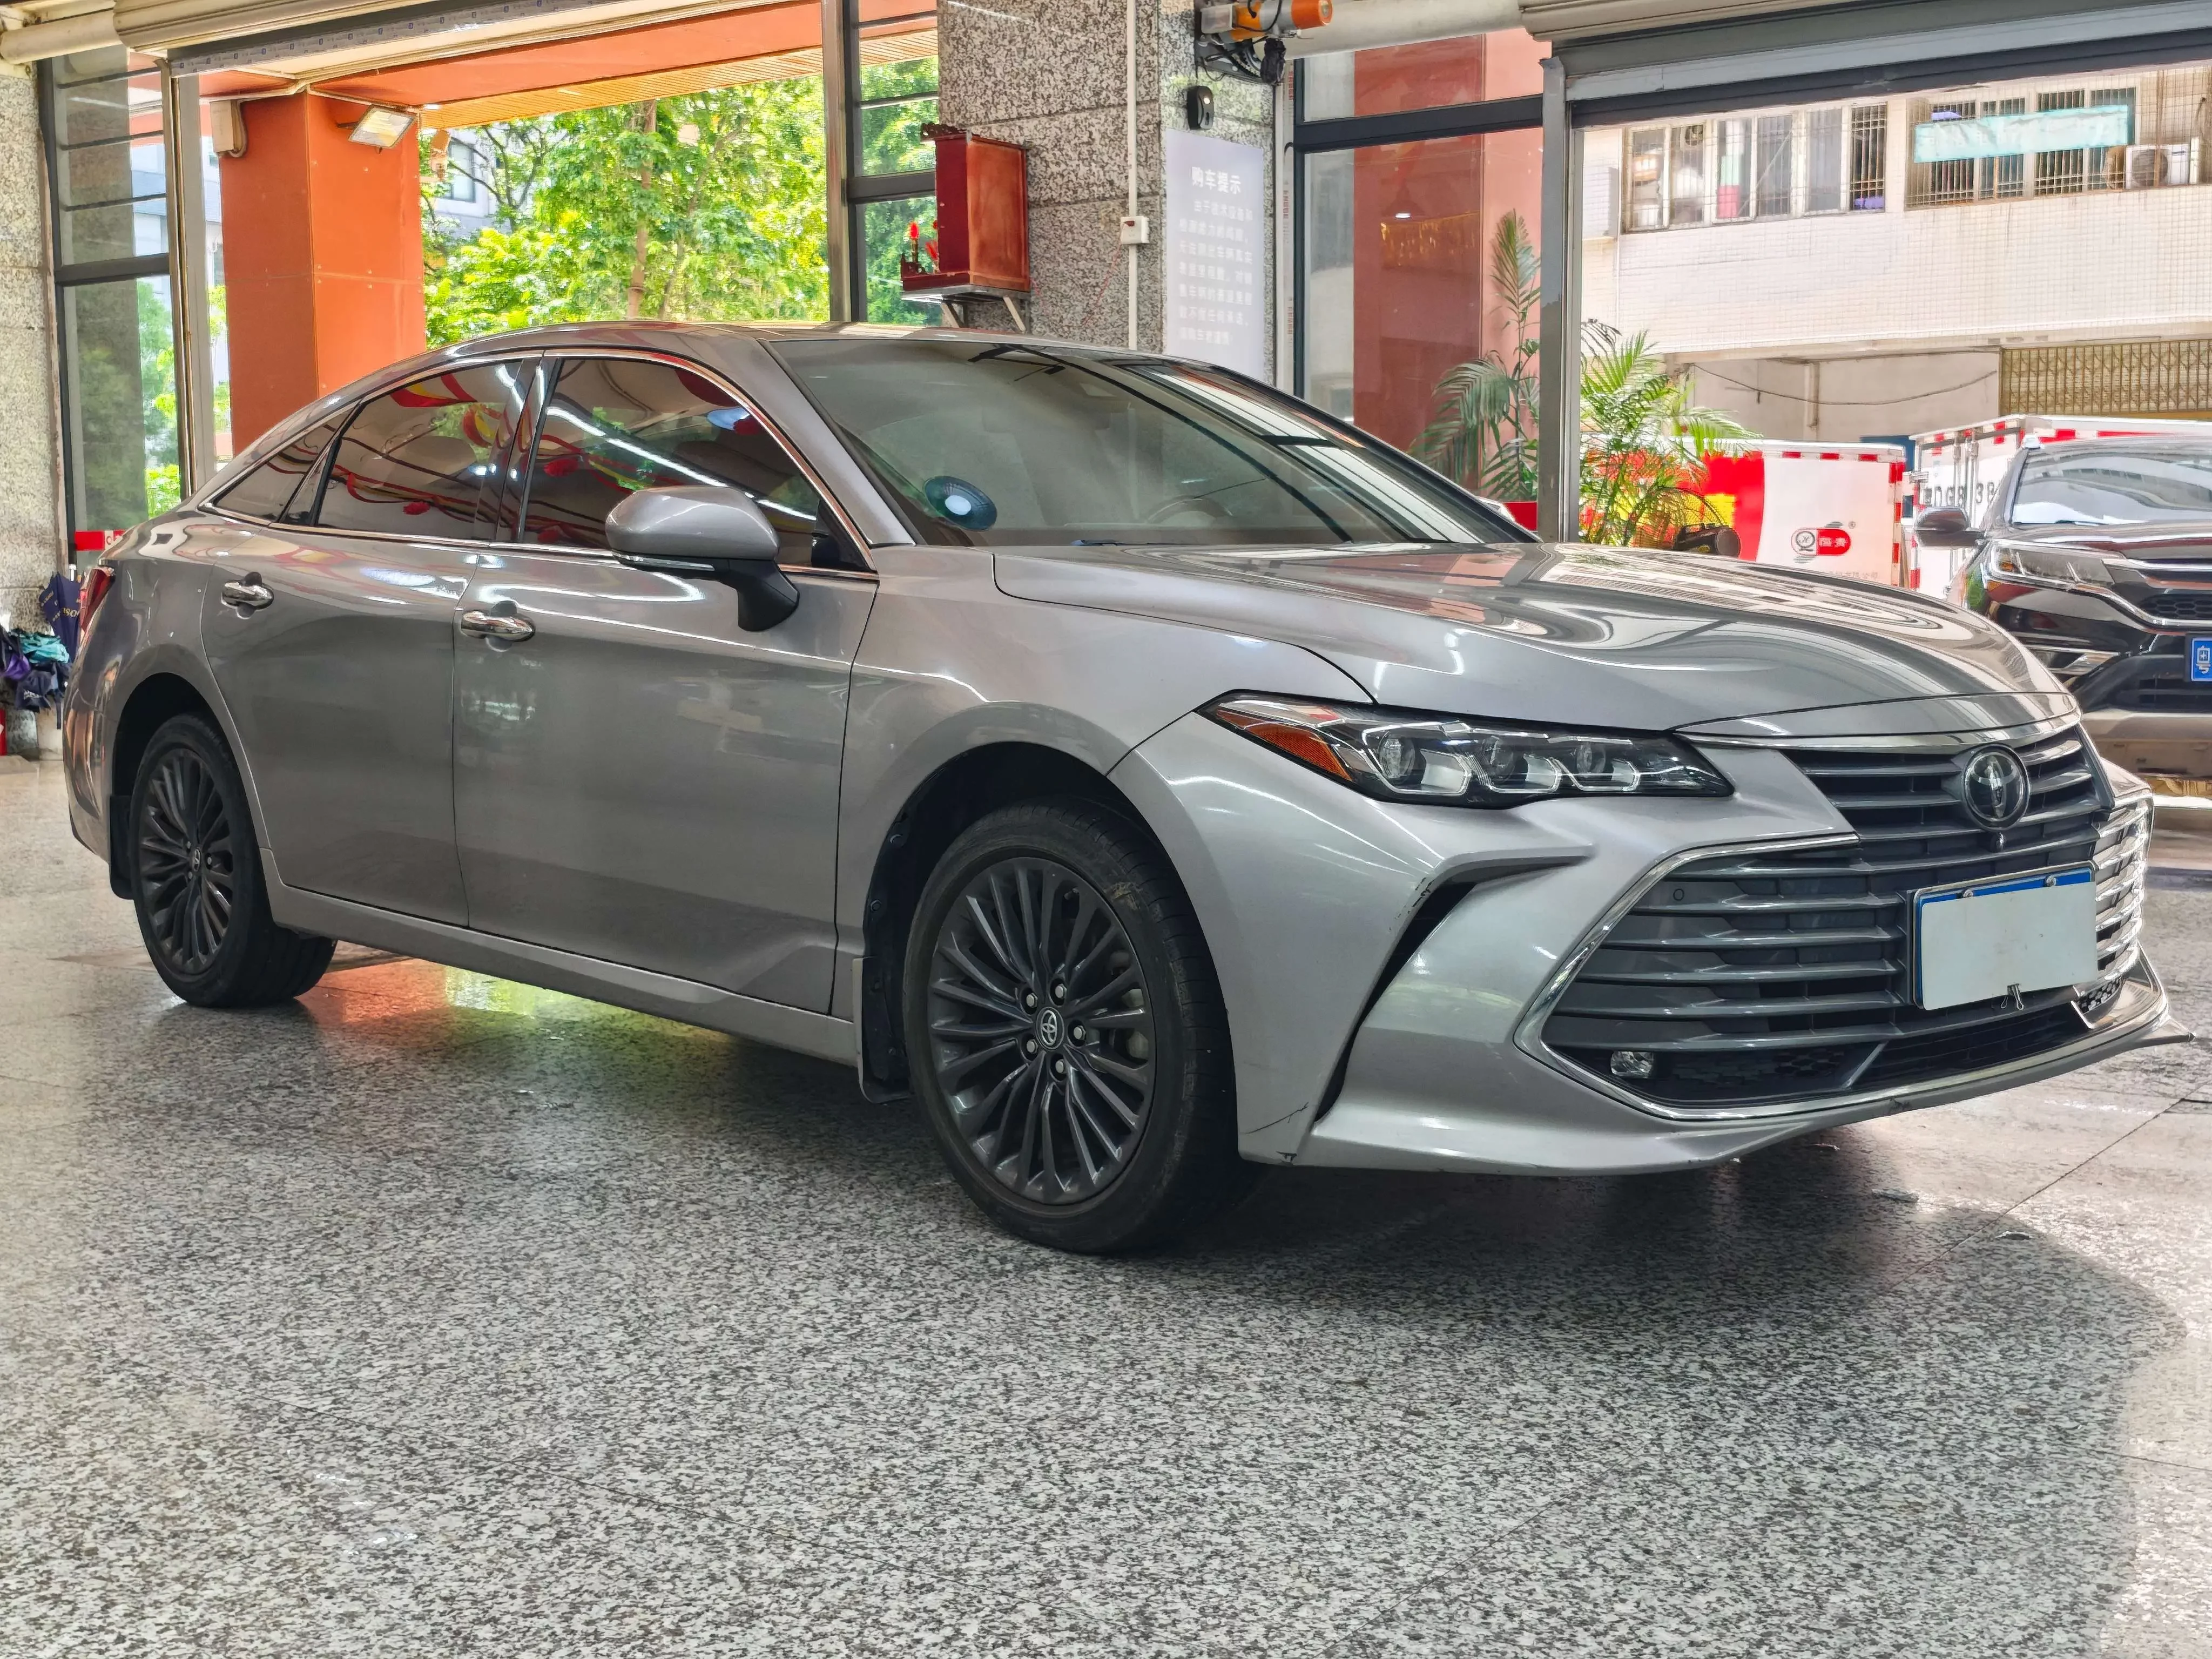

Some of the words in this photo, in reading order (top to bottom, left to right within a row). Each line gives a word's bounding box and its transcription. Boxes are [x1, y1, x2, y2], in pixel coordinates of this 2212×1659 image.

[1191, 166, 1242, 194] 购车提示
[2196, 645, 2211, 675] 粤
